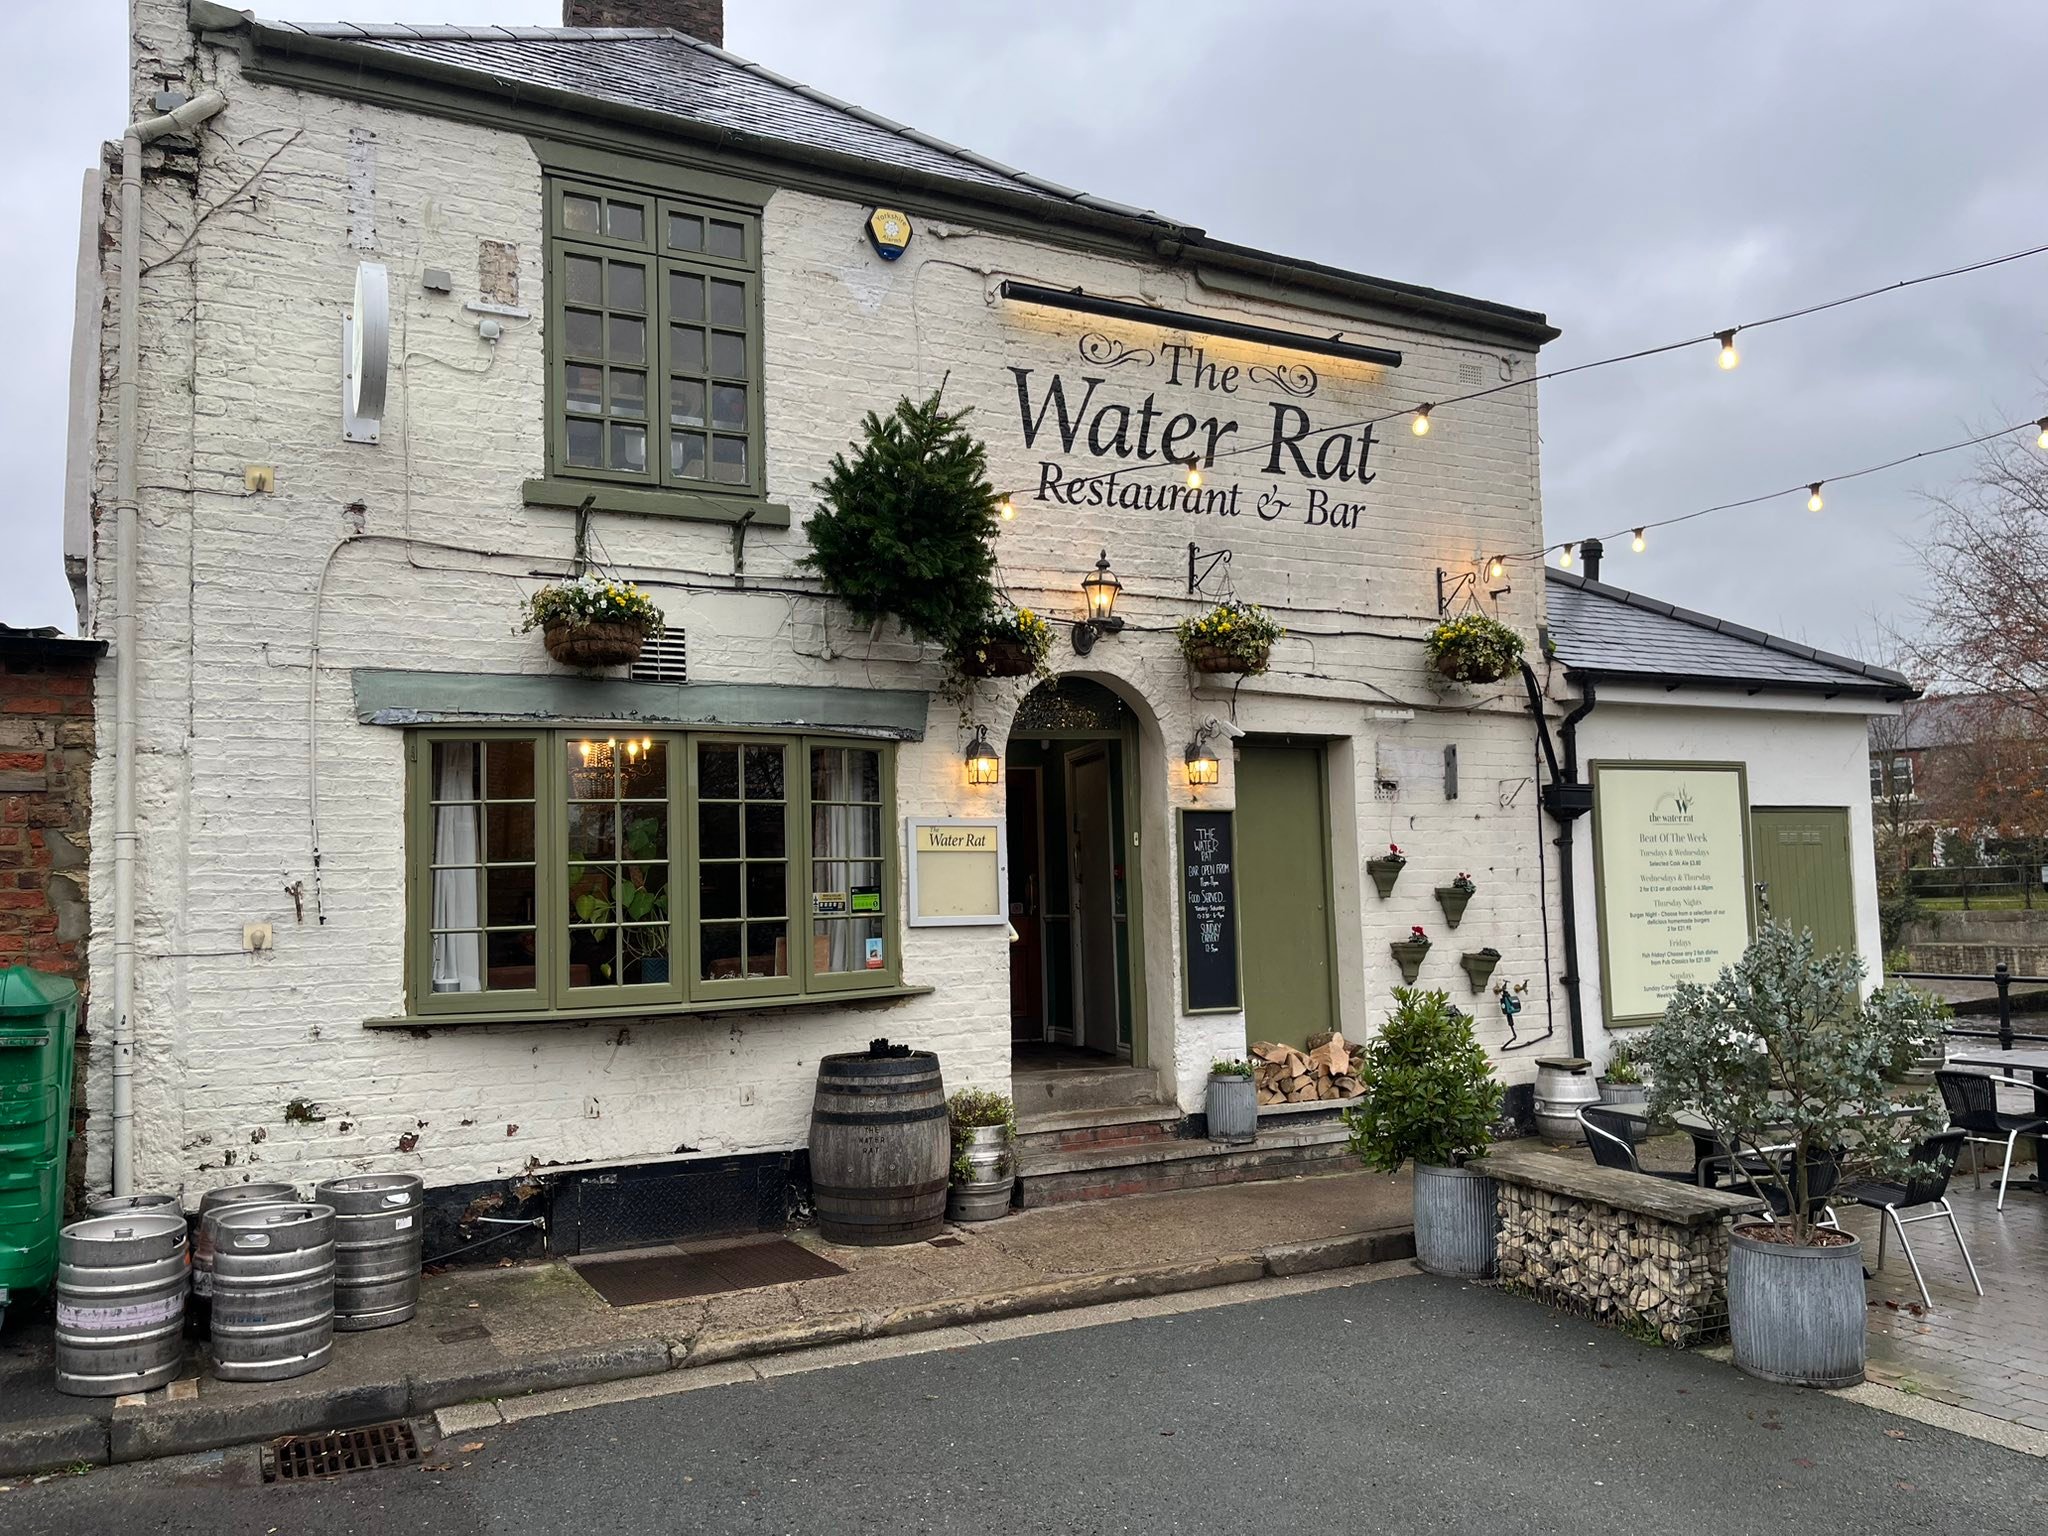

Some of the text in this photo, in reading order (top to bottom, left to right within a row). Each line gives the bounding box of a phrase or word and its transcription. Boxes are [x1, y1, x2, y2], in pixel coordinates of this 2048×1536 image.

[876, 212, 907, 227] Yorkshire
[1161, 342, 1239, 393] The
[1007, 366, 1380, 485] Water Rat
[1034, 461, 1366, 530] Restaurant & Bar
[1649, 812, 1694, 823] the water rat
[930, 833, 986, 847] Water Rat
[1196, 828, 1215, 840] THE
[1659, 832, 1669, 843] Of
[1670, 832, 1685, 843] The
[1687, 832, 1708, 843] Week
[1193, 838, 1219, 852] WATER
[1201, 850, 1214, 862] RAT
[1640, 849, 1667, 858] Tuesdays
[1675, 848, 1710, 857] Wednesdays
[1189, 863, 1229, 877] BAR OPEN FROM
[1669, 940, 1691, 948] Fridays
[864, 1126, 879, 1134] THE
